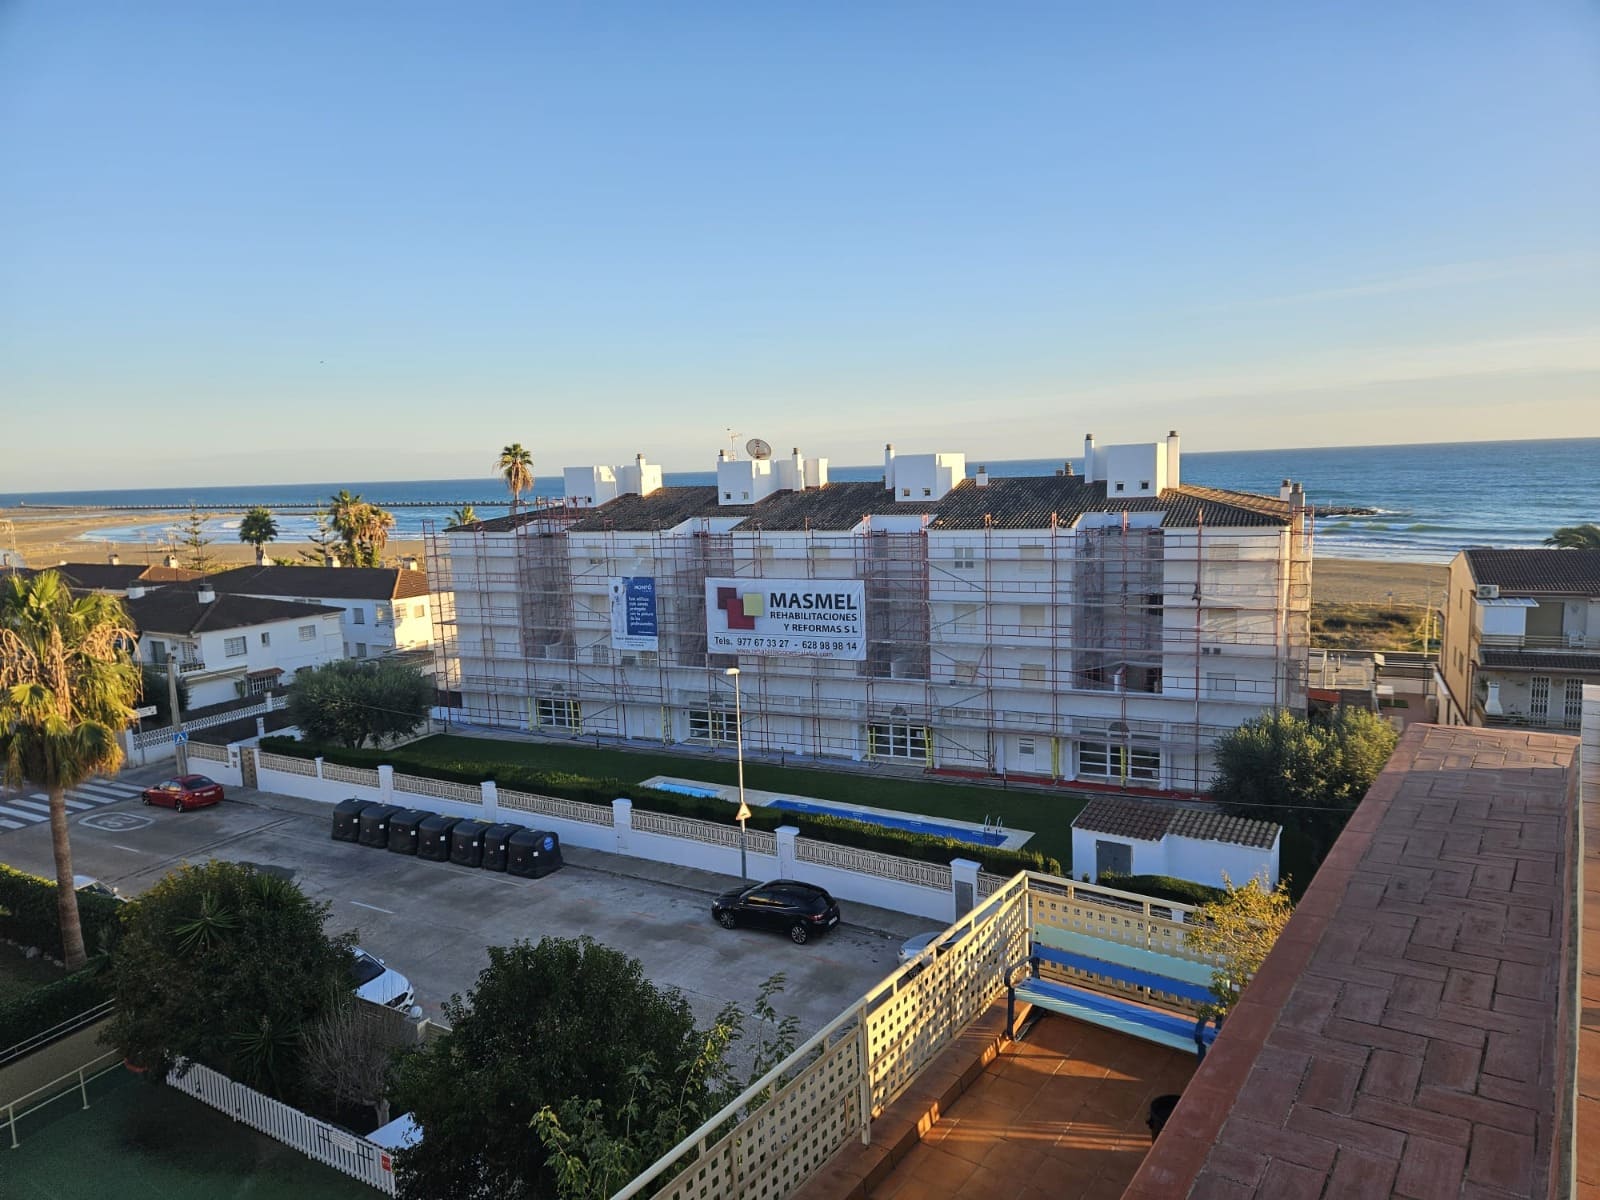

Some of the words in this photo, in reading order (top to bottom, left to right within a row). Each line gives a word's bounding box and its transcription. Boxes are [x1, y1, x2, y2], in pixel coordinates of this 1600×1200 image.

[770, 592, 857, 610] MASMEL
[770, 611, 857, 622] REHABILITACIONES
[784, 623, 790, 632] Y
[792, 624, 841, 633] REFORMAS
[844, 625, 850, 634] S
[714, 636, 733, 646] Tels.
[737, 637, 751, 647] 977
[754, 638, 764, 647] 67
[766, 639, 777, 648] 33
[779, 639, 789, 648] 27
[802, 640, 818, 650] 628
[819, 641, 830, 650] 98
[833, 641, 843, 650] 98
[846, 642, 857, 651] 14
